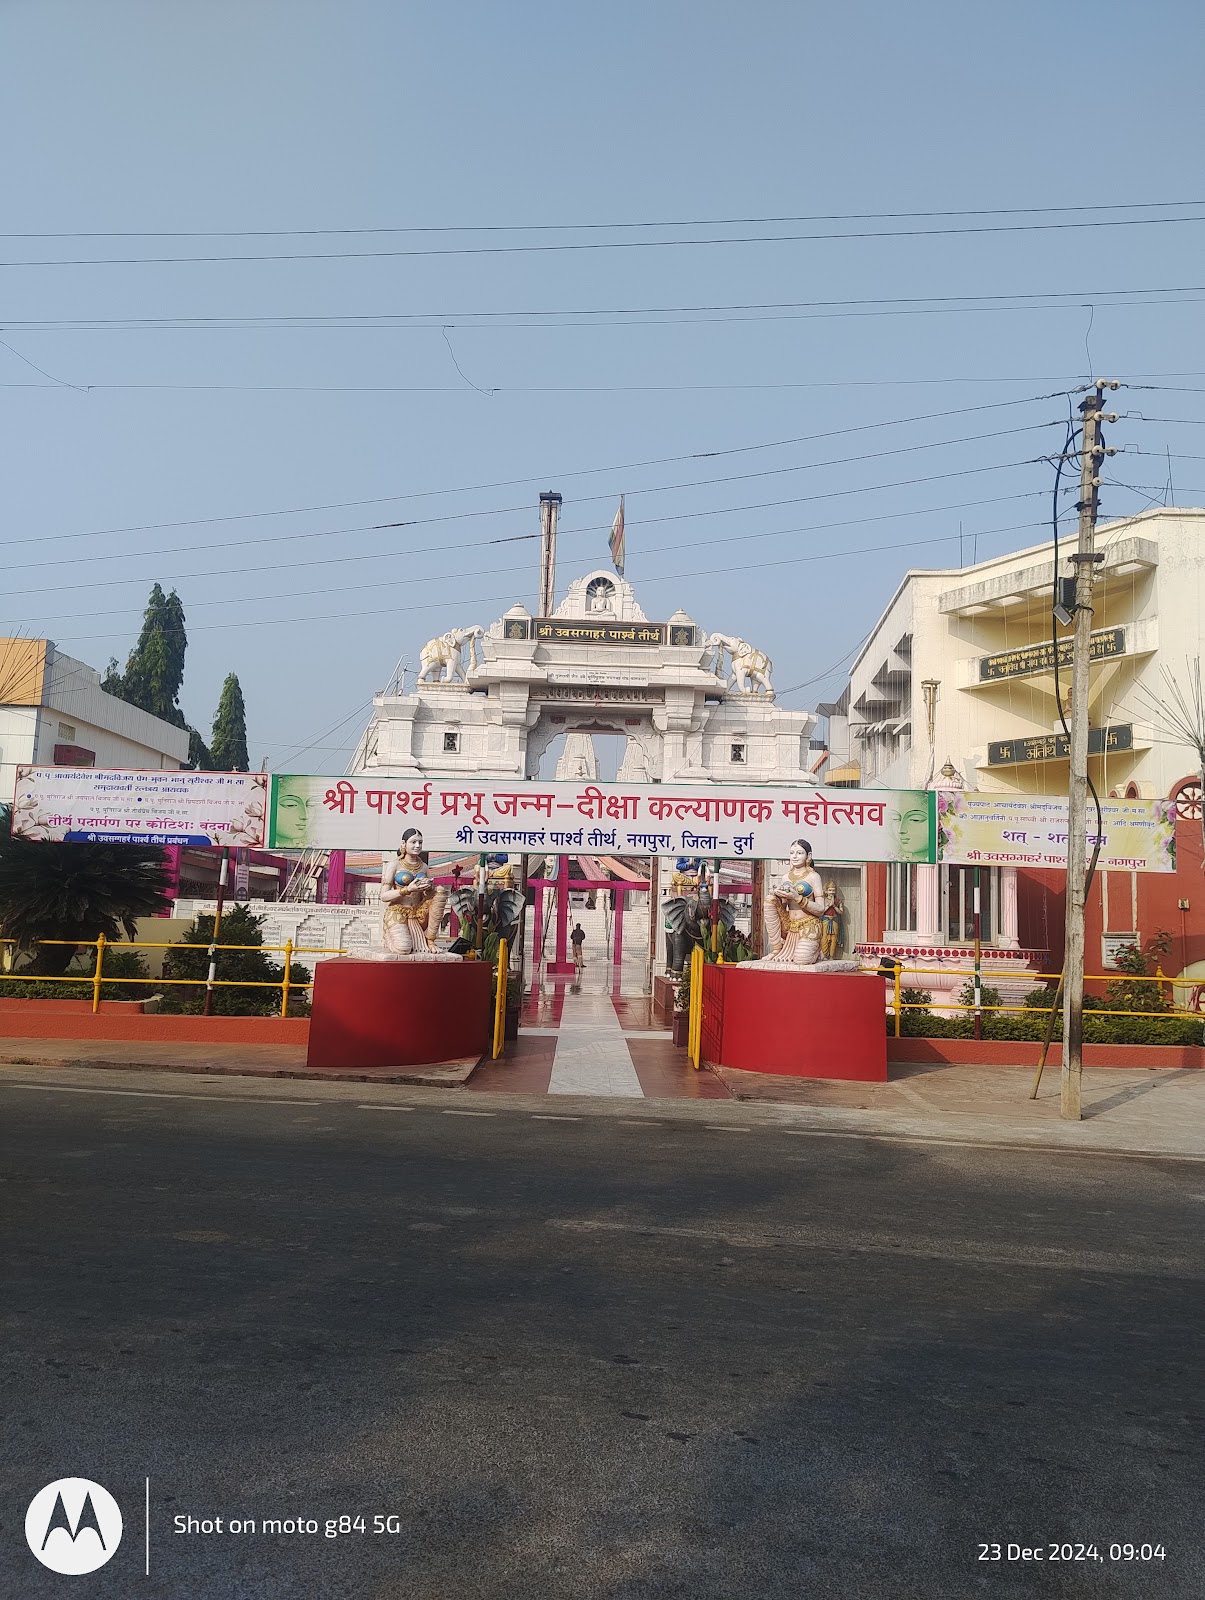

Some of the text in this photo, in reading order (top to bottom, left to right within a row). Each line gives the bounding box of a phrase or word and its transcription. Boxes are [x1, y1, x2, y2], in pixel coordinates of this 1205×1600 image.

[538, 624, 660, 641] श्री उवसग्गहरं पार्श्व तीर्थ
[1026, 744, 1056, 759] अतिथि
[215, 777, 225, 785] जी
[322, 780, 359, 815] श्री
[365, 782, 433, 816] पार्श्व
[439, 791, 490, 826] प्रभू
[647, 796, 775, 823] कल्याणक
[781, 792, 887, 827] महोत्सव
[47, 814, 231, 831] तीर्थ पदार्पण पर कोटिशः वंदना
[959, 813, 967, 821] की
[1112, 818, 1127, 827] आदि
[87, 832, 96, 842] श्री
[132, 835, 149, 844] पार्श्व
[150, 835, 166, 844] तीर्थ
[455, 825, 475, 845] श्री
[477, 827, 548, 847] उवसग्गहरं
[549, 827, 584, 847] पार्श्व
[587, 828, 622, 850] तीर्थ,
[626, 833, 676, 853] नगपुरा,
[733, 832, 755, 855] दुर्ग
[1002, 830, 1029, 846] शत्
[966, 850, 981, 861] श्री
[983, 852, 1042, 864] उवसग्गहरं
[1107, 857, 1147, 870] नगपुरा
